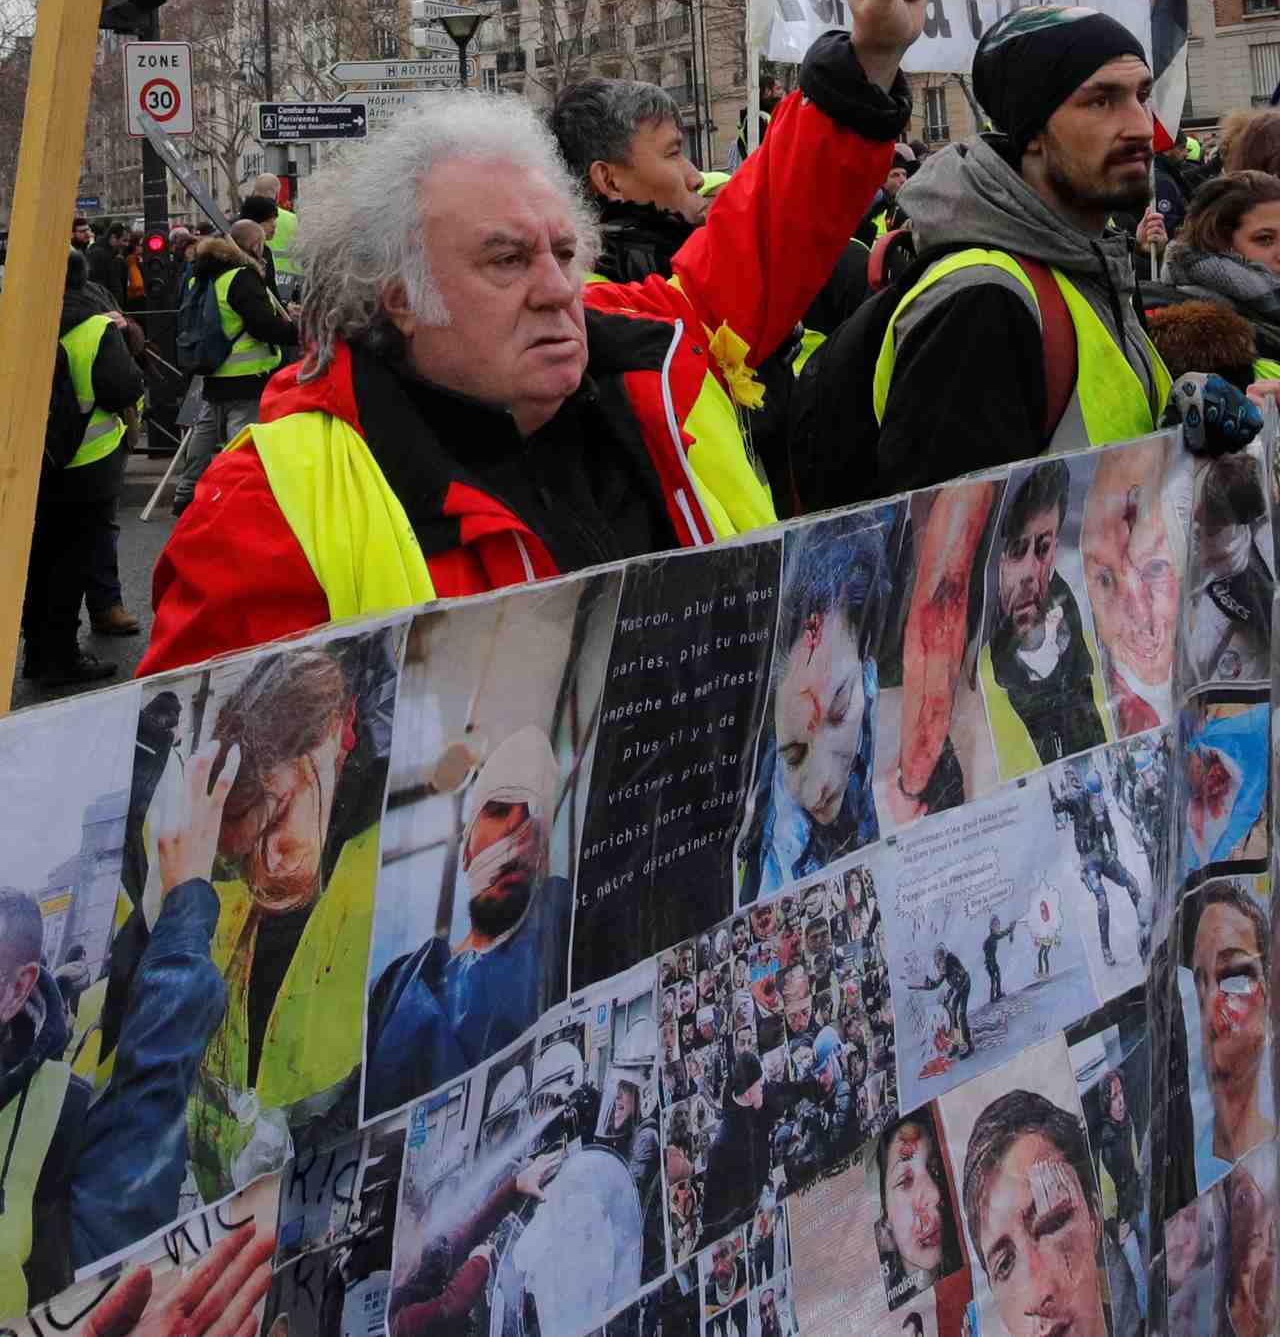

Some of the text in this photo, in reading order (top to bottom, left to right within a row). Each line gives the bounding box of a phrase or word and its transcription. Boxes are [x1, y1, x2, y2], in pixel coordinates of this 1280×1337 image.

[137, 53, 180, 69] ZONE
[400, 64, 472, 77] ROTHSCHI
[147, 89, 173, 110] 30
[684, 600, 714, 621] plus
[723, 593, 736, 607] tu
[680, 643, 711, 663] plus
[716, 635, 730, 648] tu
[739, 628, 769, 644] nous
[671, 689, 687, 706] de
[623, 741, 659, 761] plus
[691, 728, 700, 742] y
[719, 713, 735, 729] de
[681, 760, 715, 782] plus
[722, 752, 737, 766] tu
[582, 823, 649, 861] enrichis
[655, 803, 692, 829] notre
